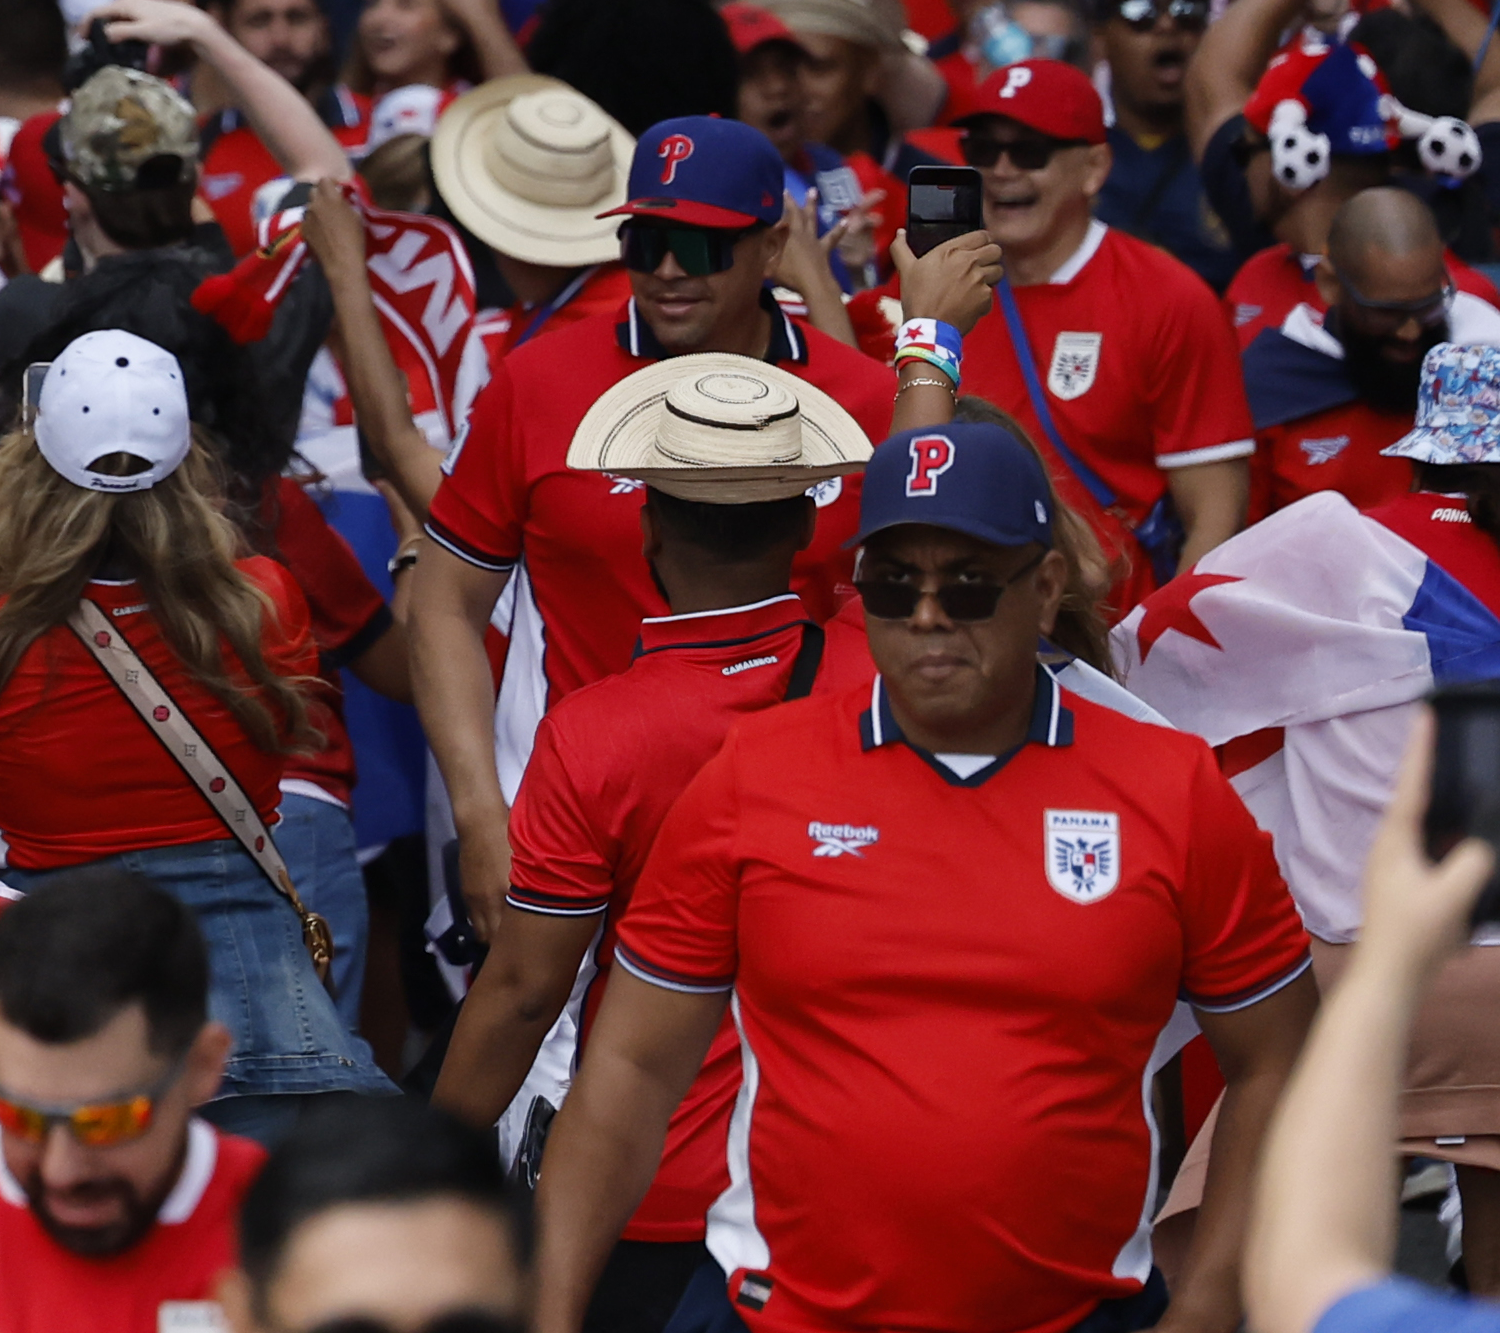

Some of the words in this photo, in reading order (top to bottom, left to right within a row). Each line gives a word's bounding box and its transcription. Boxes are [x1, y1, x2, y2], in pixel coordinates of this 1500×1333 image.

[999, 67, 1032, 98] P
[657, 133, 694, 185] P
[906, 435, 955, 497] P
[808, 821, 880, 843] Reebok
